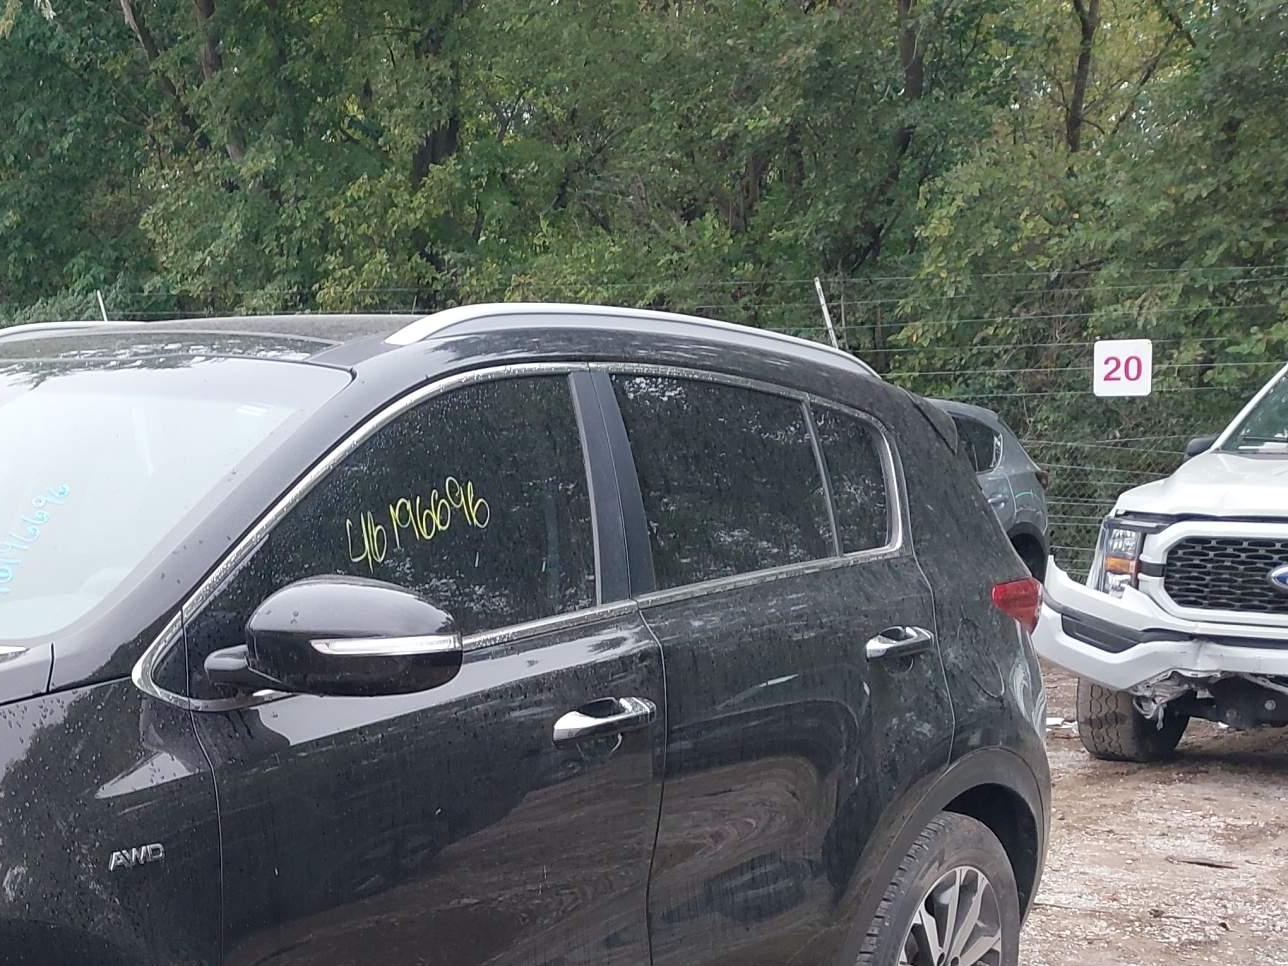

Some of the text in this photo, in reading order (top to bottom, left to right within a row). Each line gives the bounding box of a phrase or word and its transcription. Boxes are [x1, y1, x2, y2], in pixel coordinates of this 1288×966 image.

[1103, 355, 1142, 382] 20
[345, 476, 490, 573] 46196696
[108, 843, 166, 872] AWD
